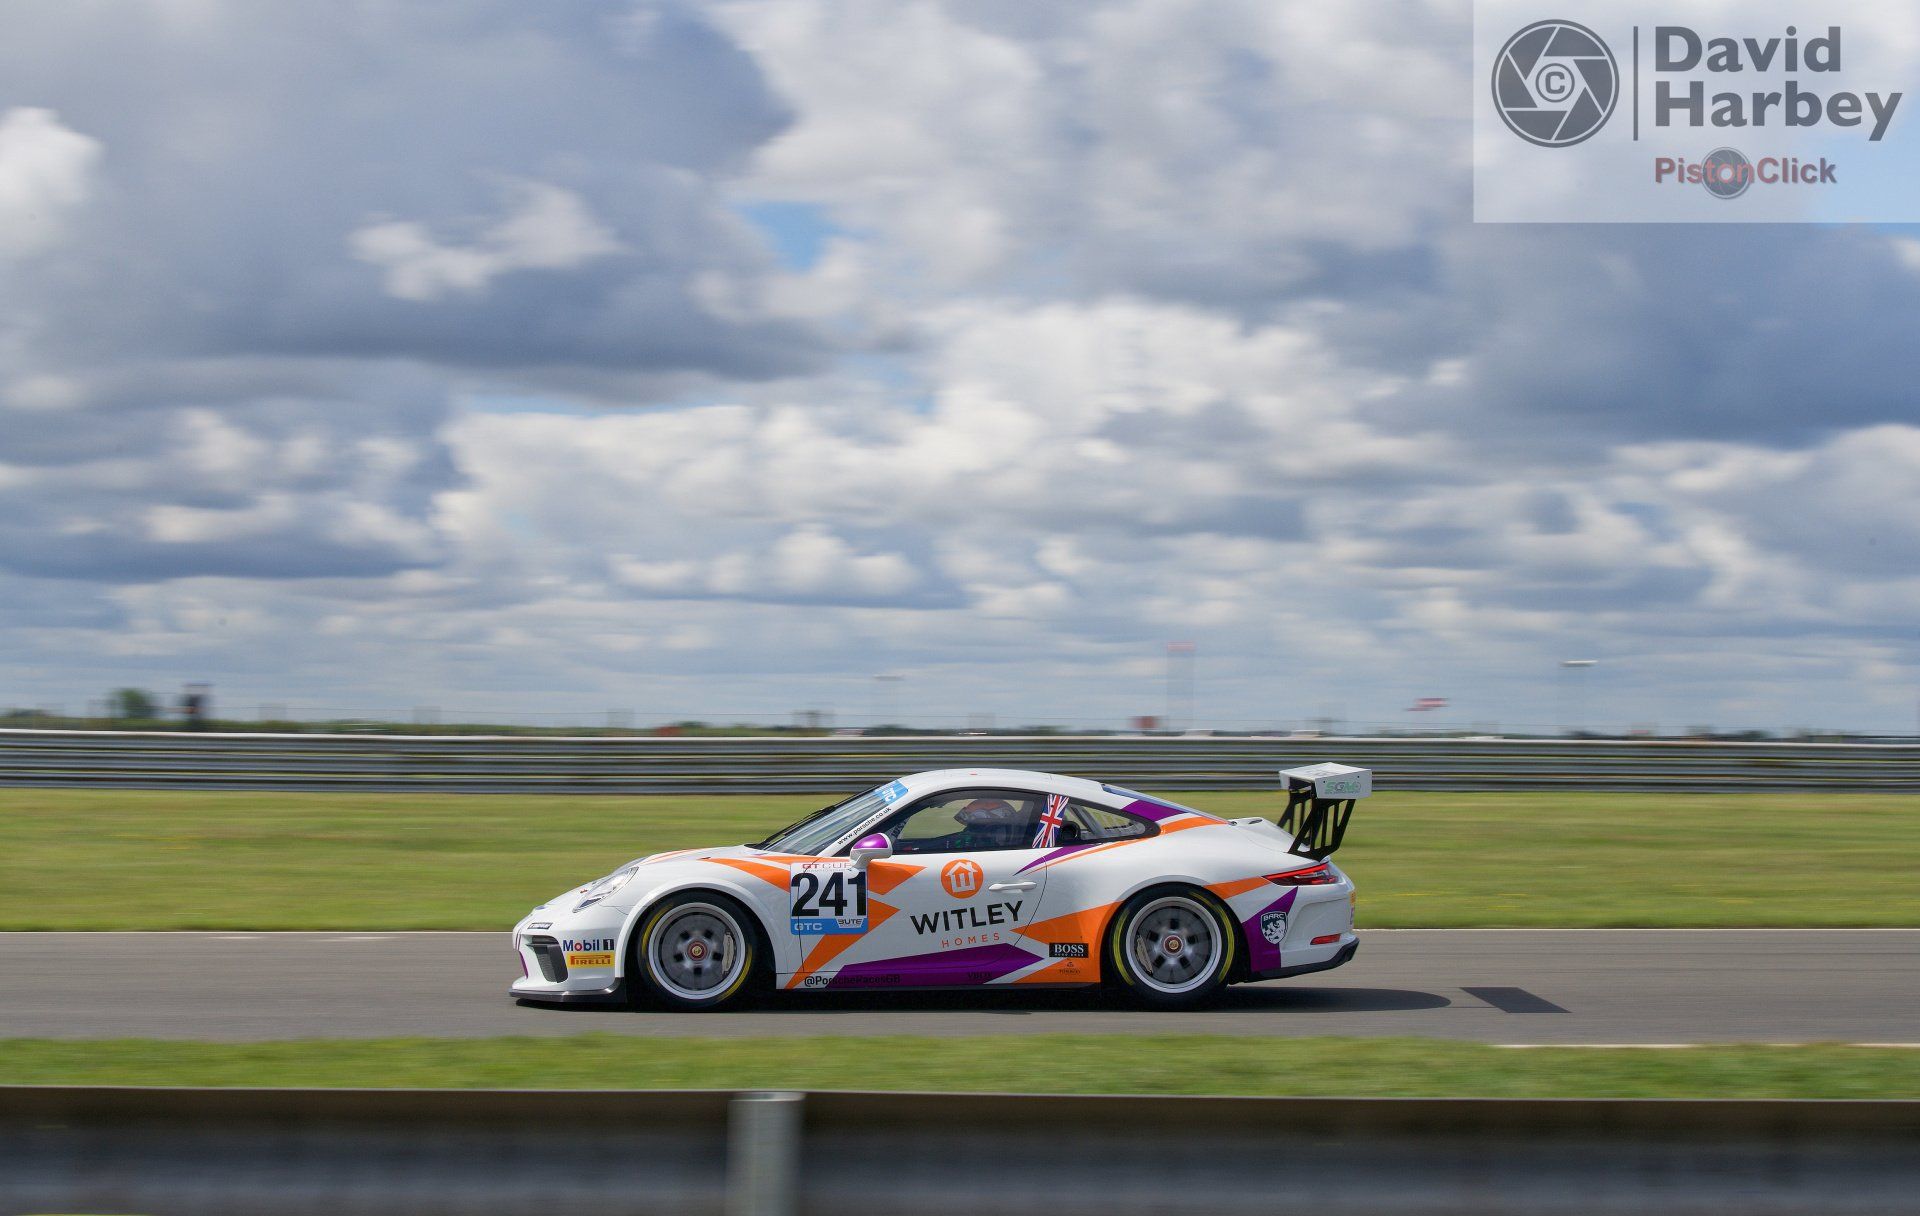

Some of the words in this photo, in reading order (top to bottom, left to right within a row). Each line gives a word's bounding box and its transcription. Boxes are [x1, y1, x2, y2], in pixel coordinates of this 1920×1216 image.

[837, 807, 892, 845] www.porsche.co.uk
[790, 871, 867, 917] 241
[909, 900, 1023, 935] WITLEY
[1263, 913, 1285, 921] BARC
[794, 922, 823, 931] GTC
[562, 938, 600, 951] Mobil
[604, 939, 613, 950] 1
[941, 932, 1000, 948] HOMES
[1054, 944, 1084, 953] BOSS
[570, 954, 611, 966] PIRELLI
